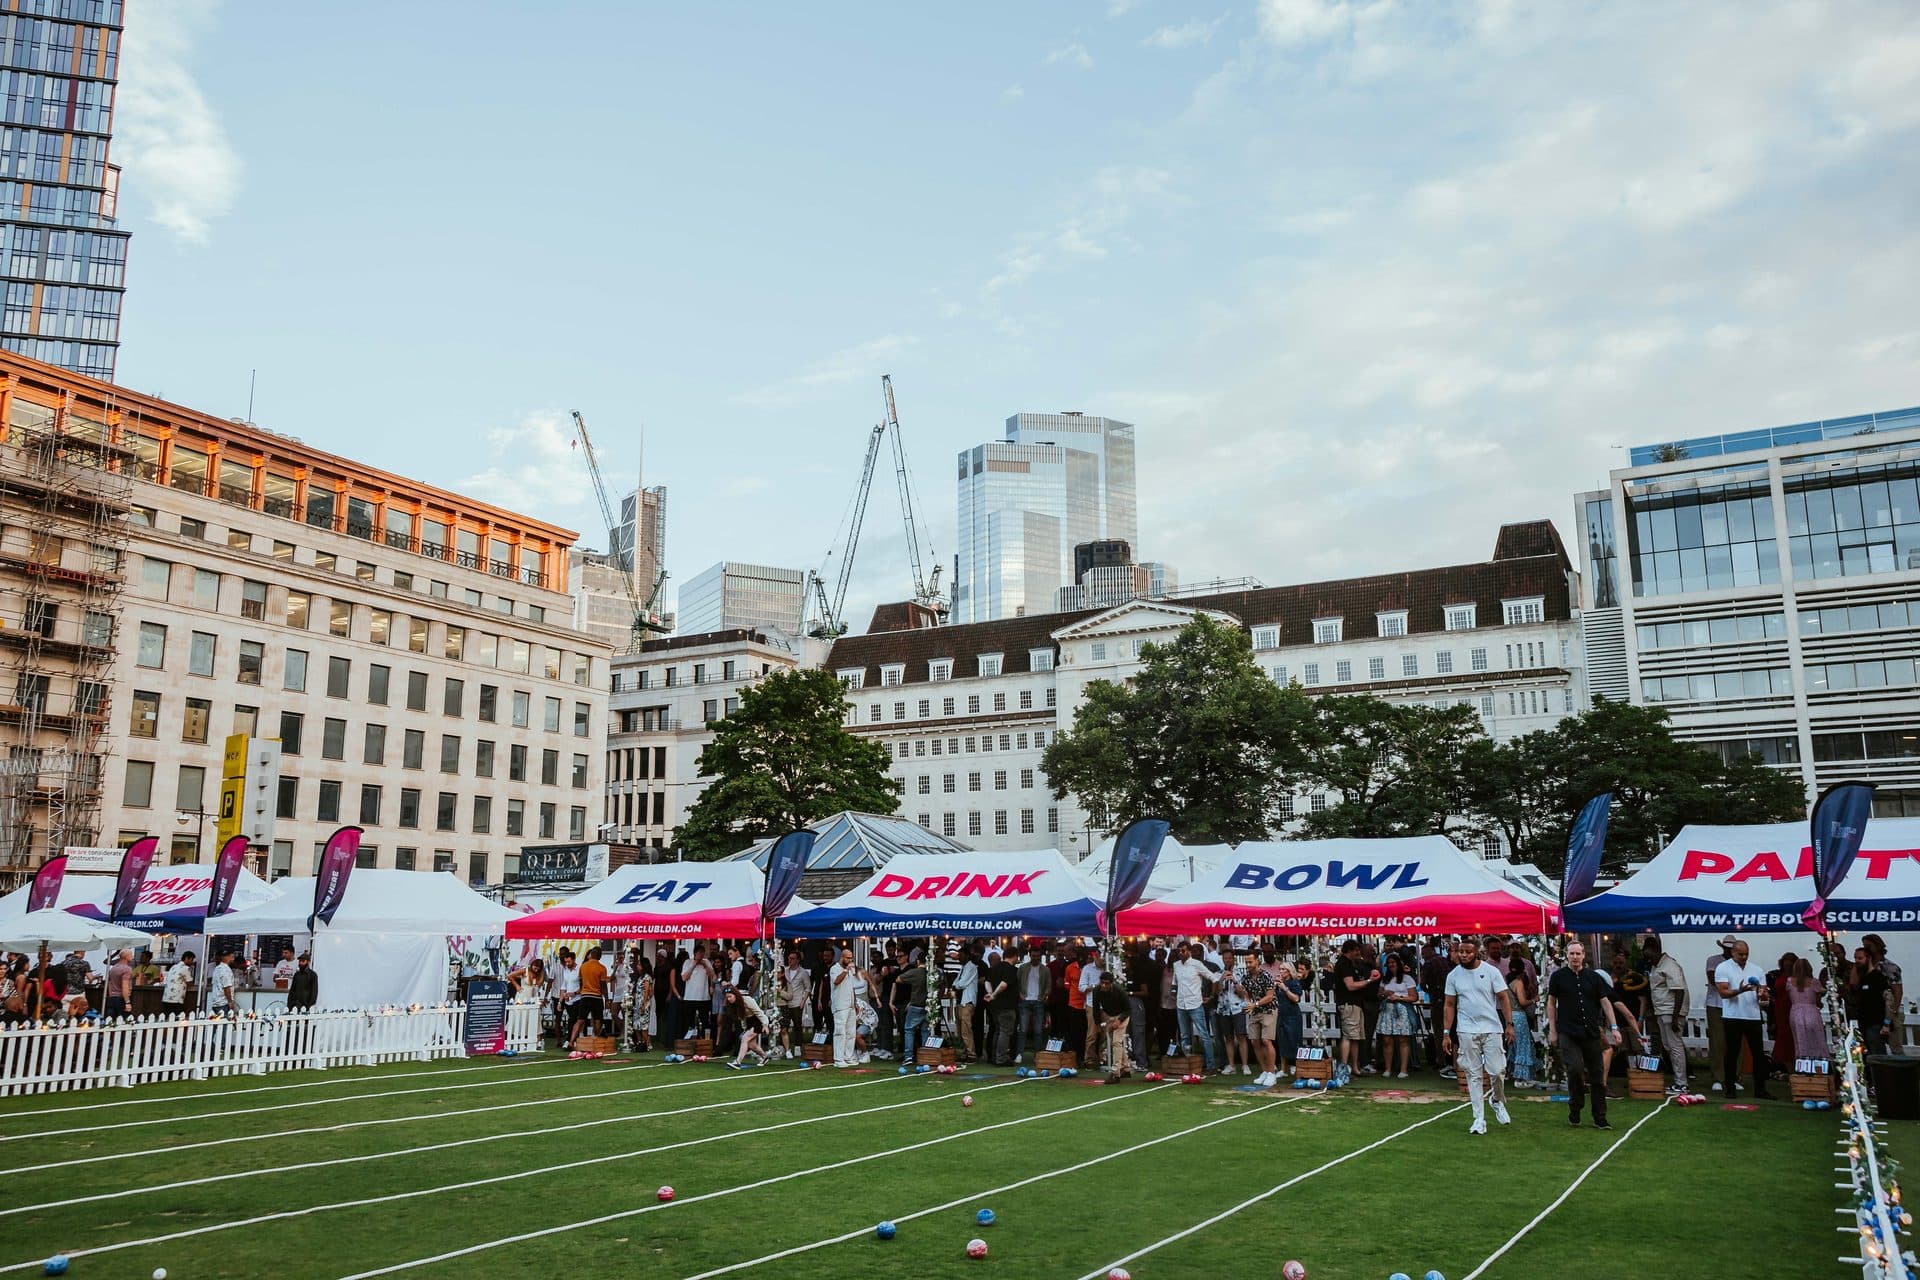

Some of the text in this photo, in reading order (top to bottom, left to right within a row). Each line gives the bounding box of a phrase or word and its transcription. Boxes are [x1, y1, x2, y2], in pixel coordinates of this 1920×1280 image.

[223, 793, 233, 817] P
[527, 852, 581, 869] OPEN
[1677, 846, 1920, 884] PAT
[867, 869, 1050, 901] DRINK
[1223, 860, 1429, 892] BOWL
[615, 879, 713, 905] EAT
[843, 919, 1023, 931] WWW.THEBOWLSCLUBLDN.COM
[1204, 916, 1438, 929] WWW.THEBOWLSCLUBLDN.COM
[1671, 909, 1920, 926] WWW.THEBOSCLUBLD
[560, 924, 703, 934] WWW.THEBOWLSCLUBLDN.COM
